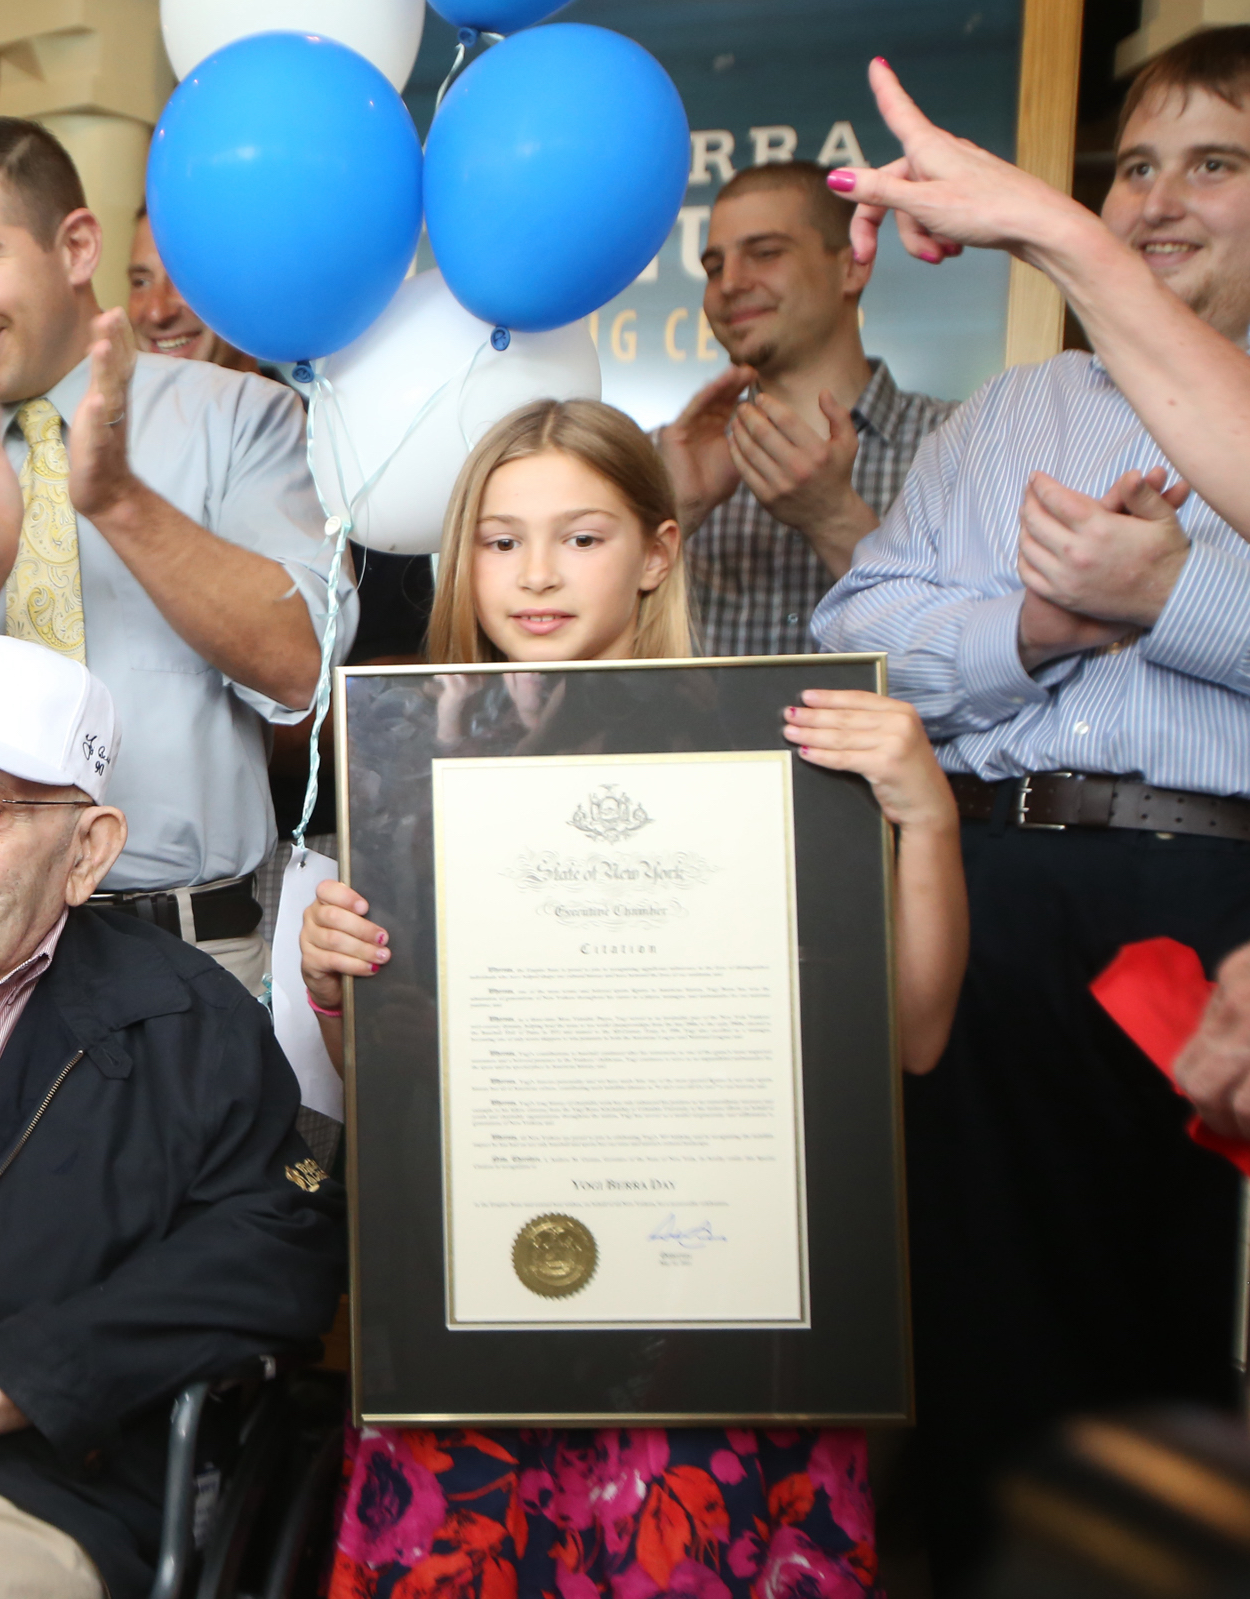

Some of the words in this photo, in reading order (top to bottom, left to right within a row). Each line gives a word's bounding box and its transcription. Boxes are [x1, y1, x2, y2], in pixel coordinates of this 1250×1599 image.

[531, 858, 580, 882] State
[583, 867, 599, 882] of
[602, 860, 640, 882] New
[641, 860, 686, 884] York
[554, 904, 610, 918] Executive
[613, 904, 669, 917] Chamber
[580, 942, 658, 955] Citation
[570, 1179, 603, 1190] YOGI
[606, 1179, 648, 1190] BERRA
[650, 1179, 675, 1190] DAY
